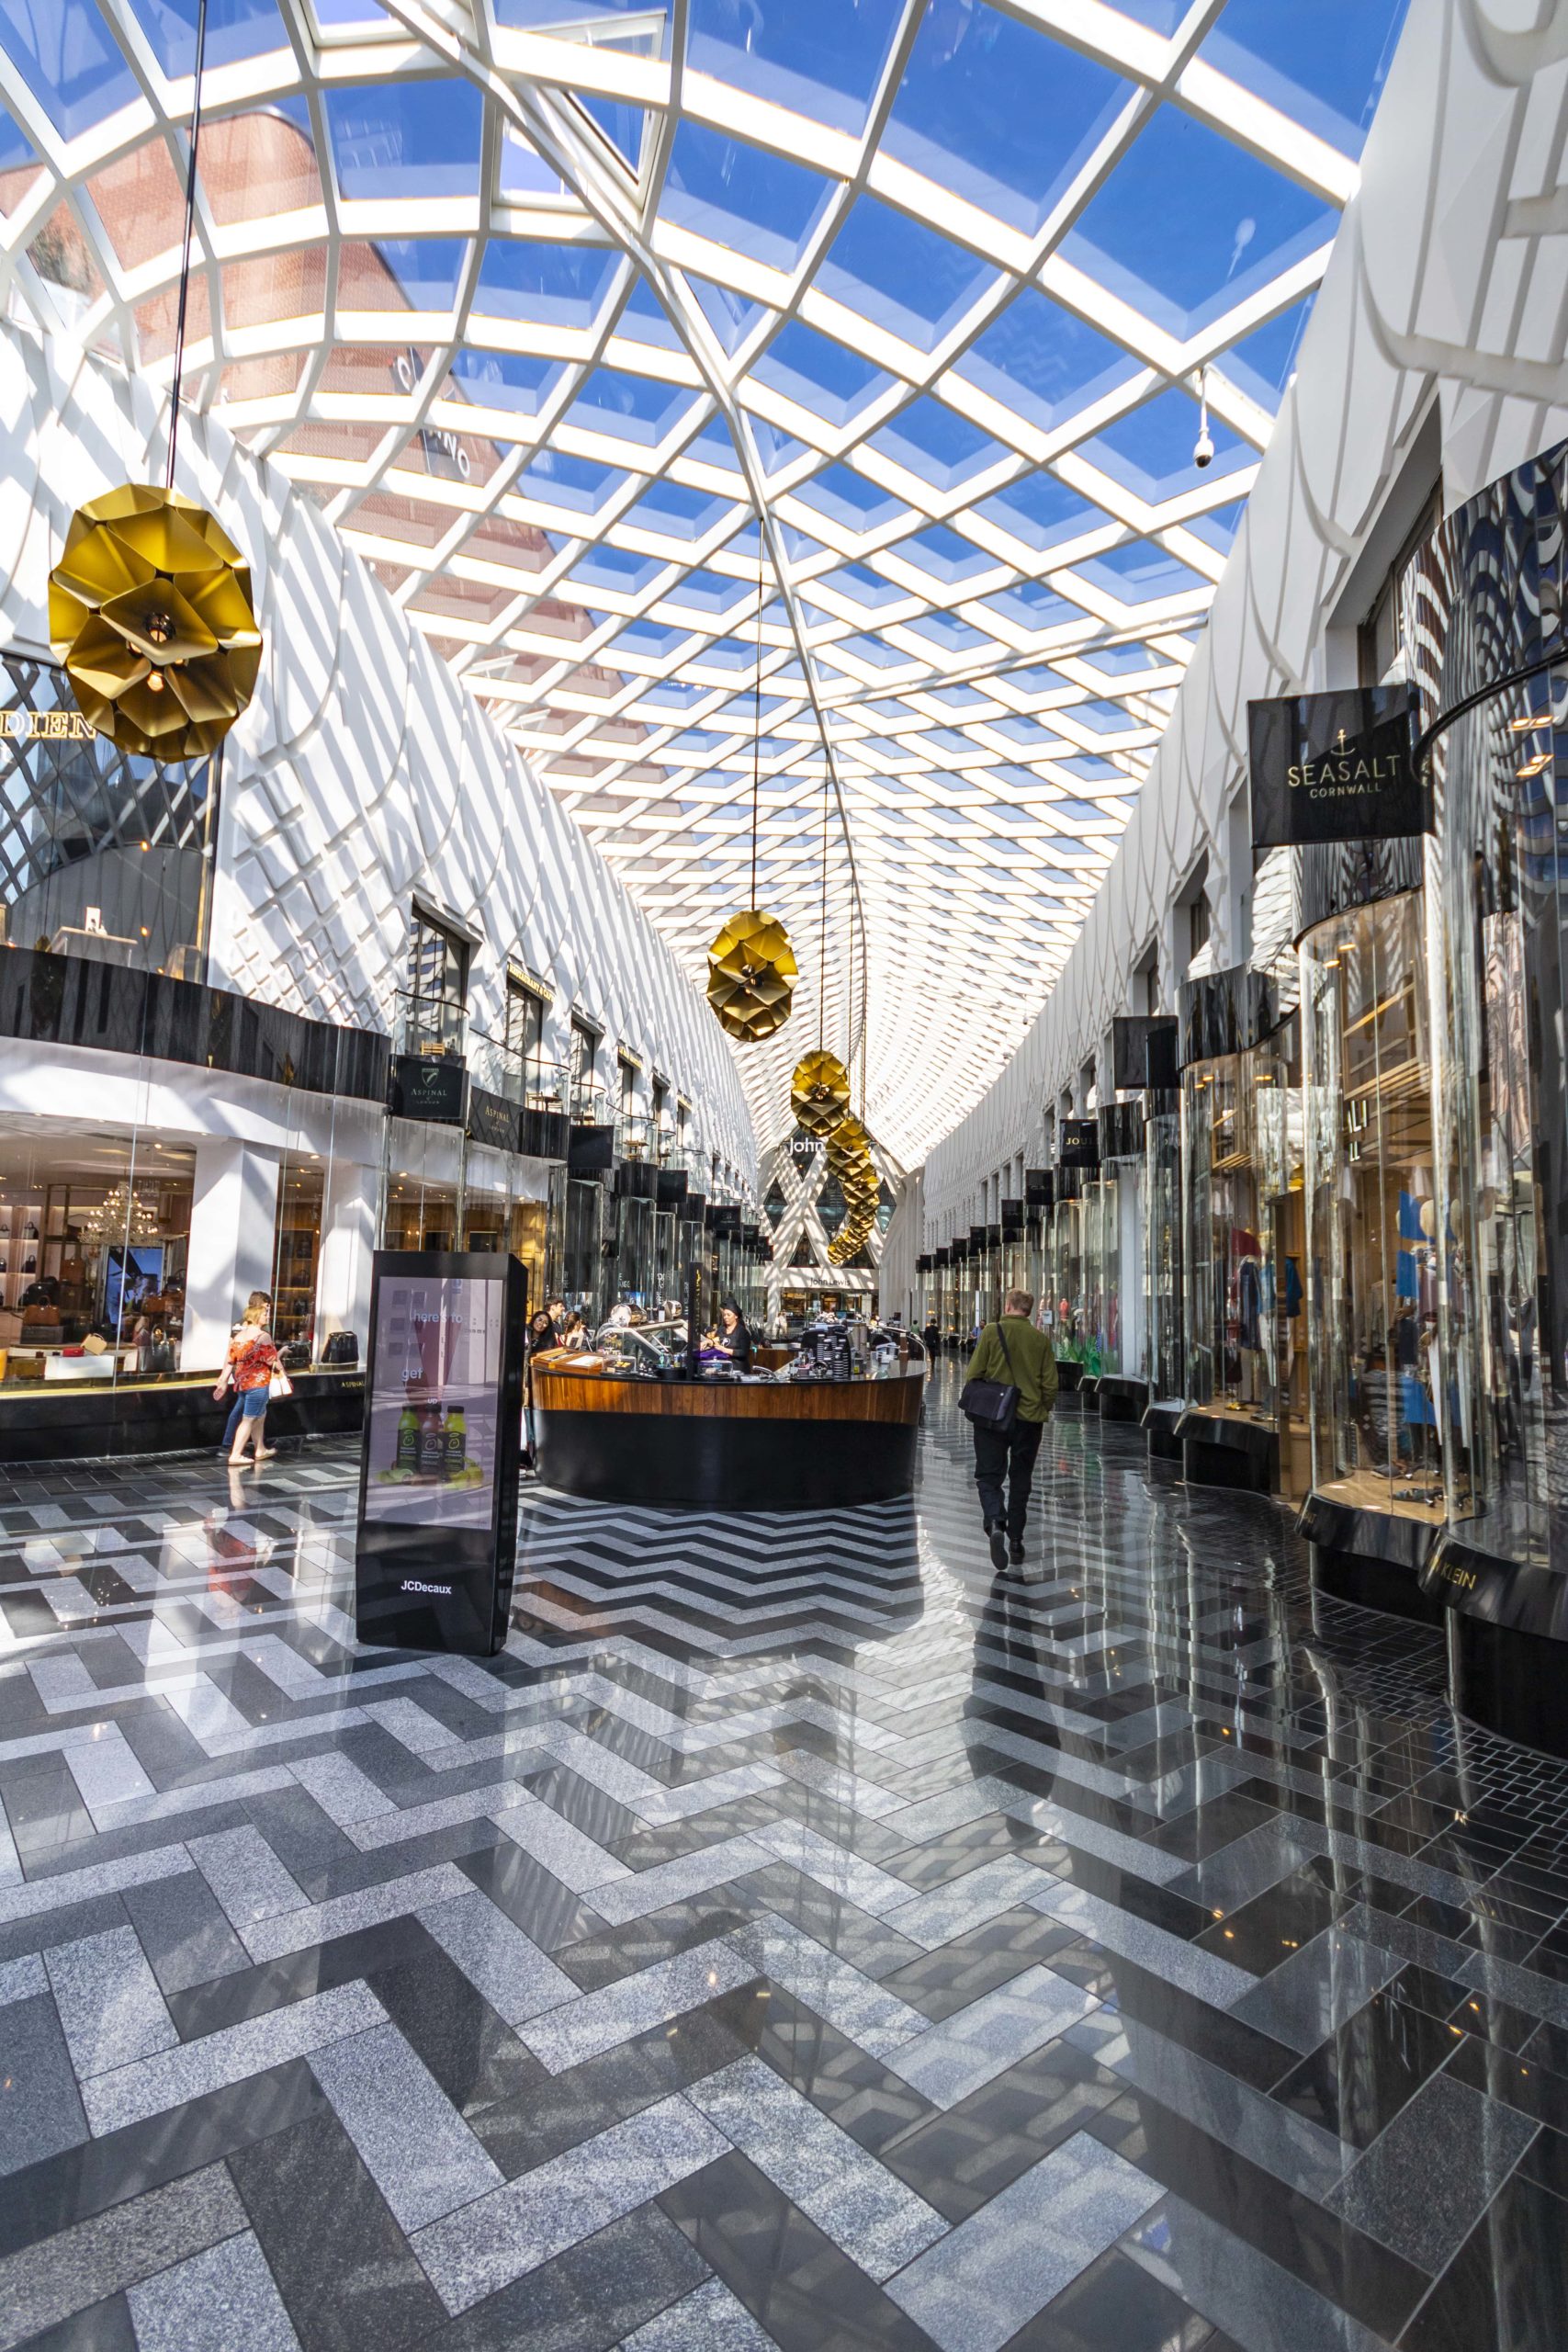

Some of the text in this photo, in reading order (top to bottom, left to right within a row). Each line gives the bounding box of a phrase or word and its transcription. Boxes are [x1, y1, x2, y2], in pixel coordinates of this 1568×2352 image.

[1287, 754, 1401, 787] SEASALT
[1309, 783, 1382, 799] CORNWALL
[411, 1088, 447, 1096] ASPINAL
[787, 1137, 825, 1157] John
[809, 1277, 828, 1287] John
[451, 1311, 464, 1323] to
[401, 1366, 423, 1382] get
[427, 1397, 438, 1406] up
[1439, 1562, 1477, 1590] KLEIN
[400, 1579, 452, 1595] JCDecaux
